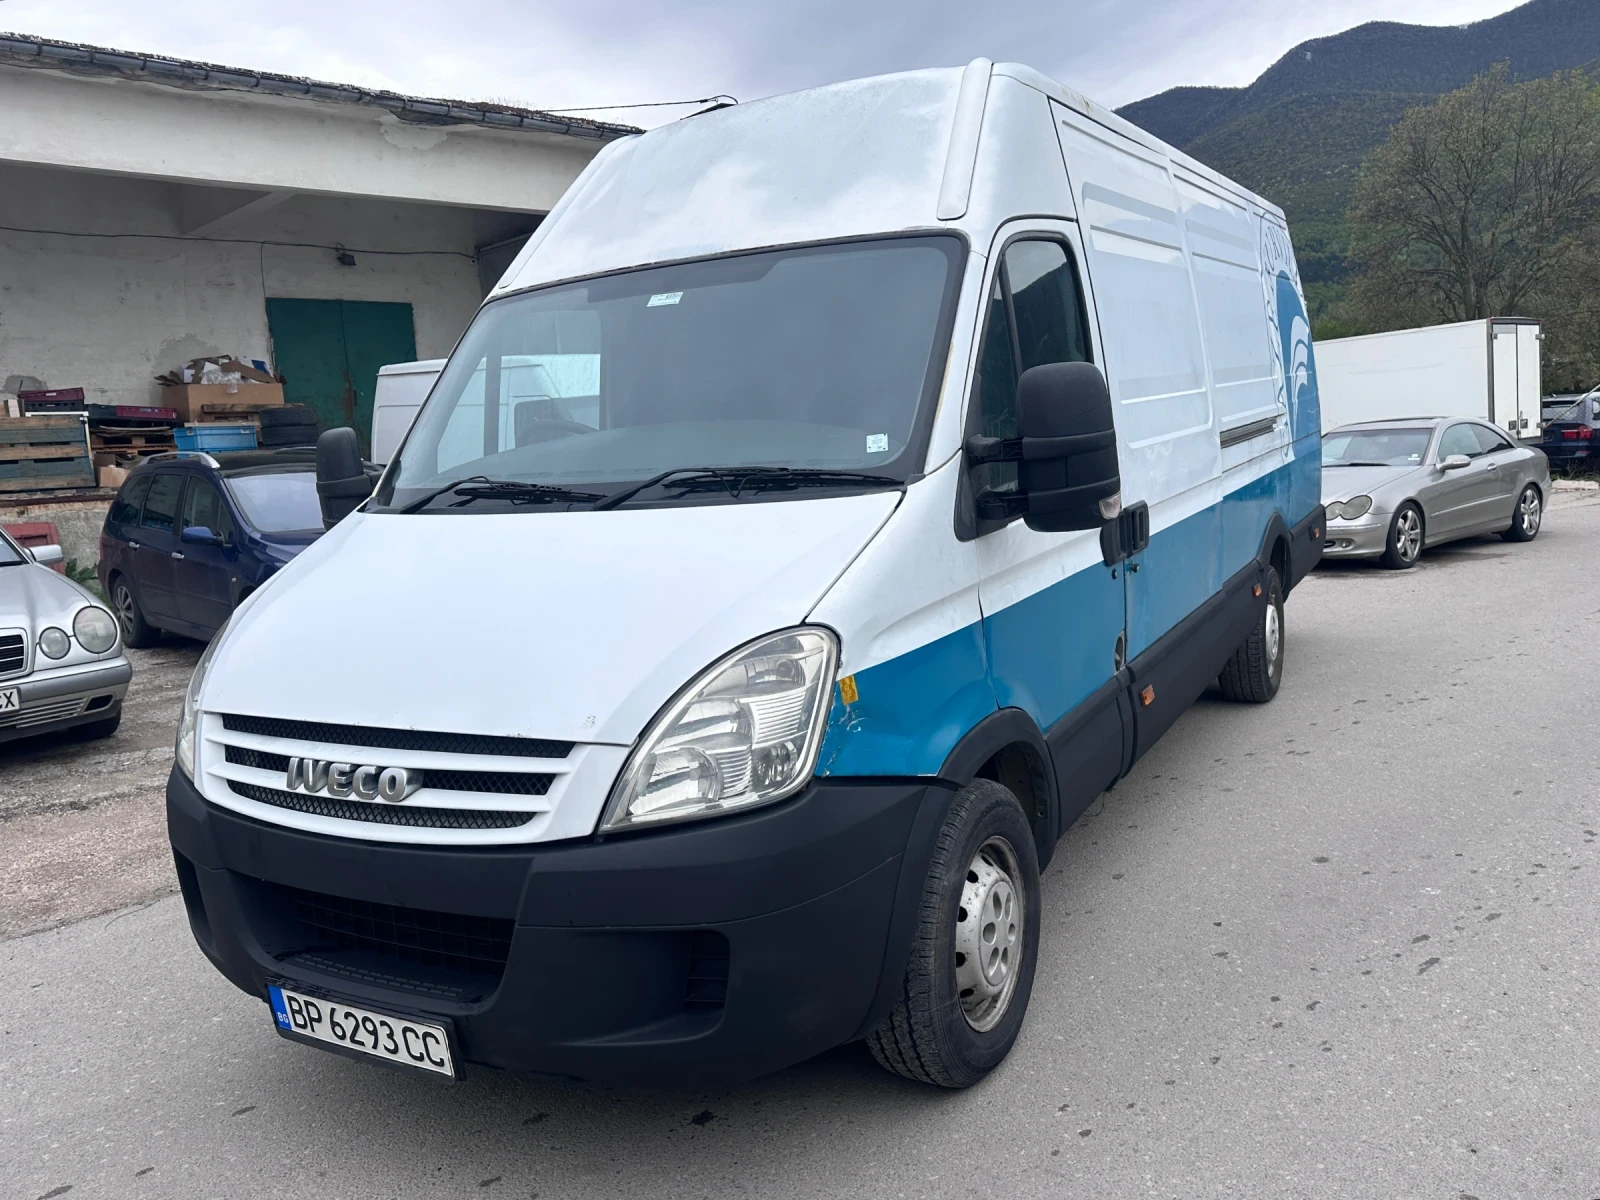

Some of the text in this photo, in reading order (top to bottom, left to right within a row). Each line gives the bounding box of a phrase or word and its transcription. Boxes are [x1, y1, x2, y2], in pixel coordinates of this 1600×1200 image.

[0, 691, 15, 709] X
[286, 757, 412, 803] IVECO
[277, 1011, 289, 1024] BG
[286, 994, 445, 1067] BP 6293 CC
